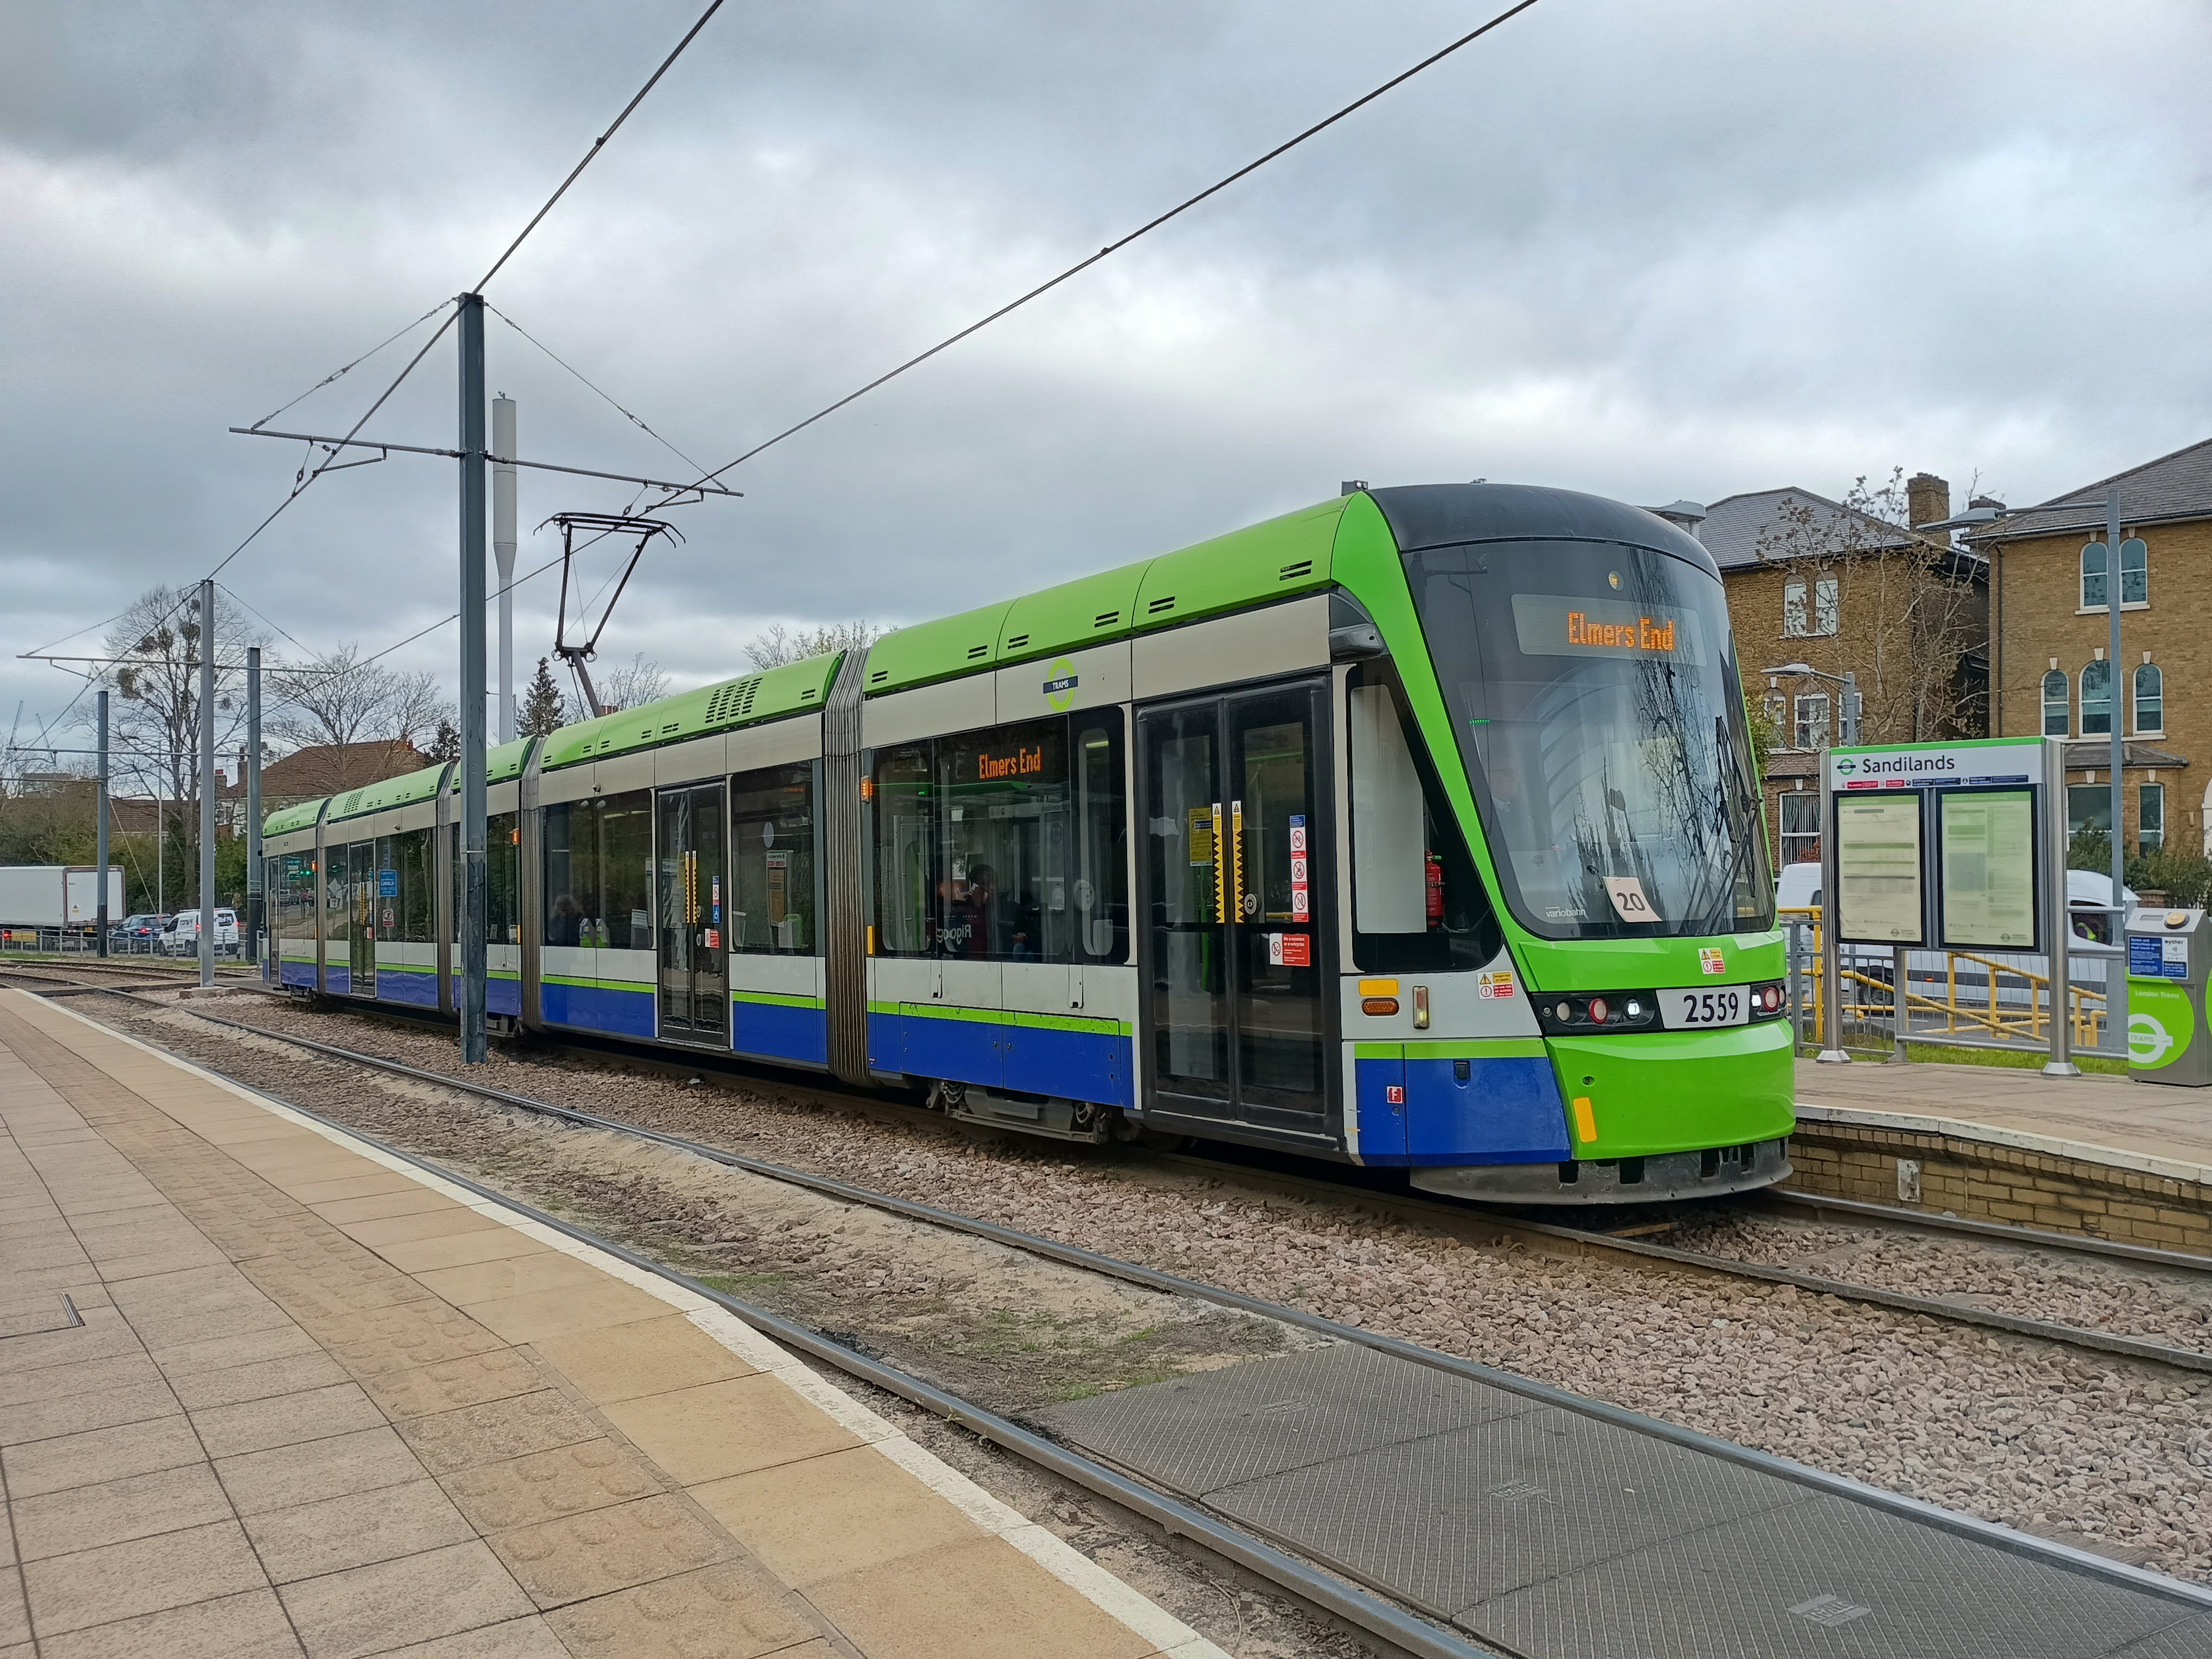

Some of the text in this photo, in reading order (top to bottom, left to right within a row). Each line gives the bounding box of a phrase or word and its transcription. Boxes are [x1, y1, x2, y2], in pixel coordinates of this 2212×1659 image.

[1568, 612, 1673, 651] Elmers End
[1052, 679, 1069, 690] TRAMS
[979, 745, 1041, 779] Elmers End
[1863, 755, 1955, 773] Sandilands
[1616, 892, 1645, 911] 20
[1545, 908, 1586, 918] variobahn
[2135, 989, 2179, 999] London Trams
[1683, 992, 1738, 1023] 2559
[2130, 1034, 2154, 1043] TRAMS
